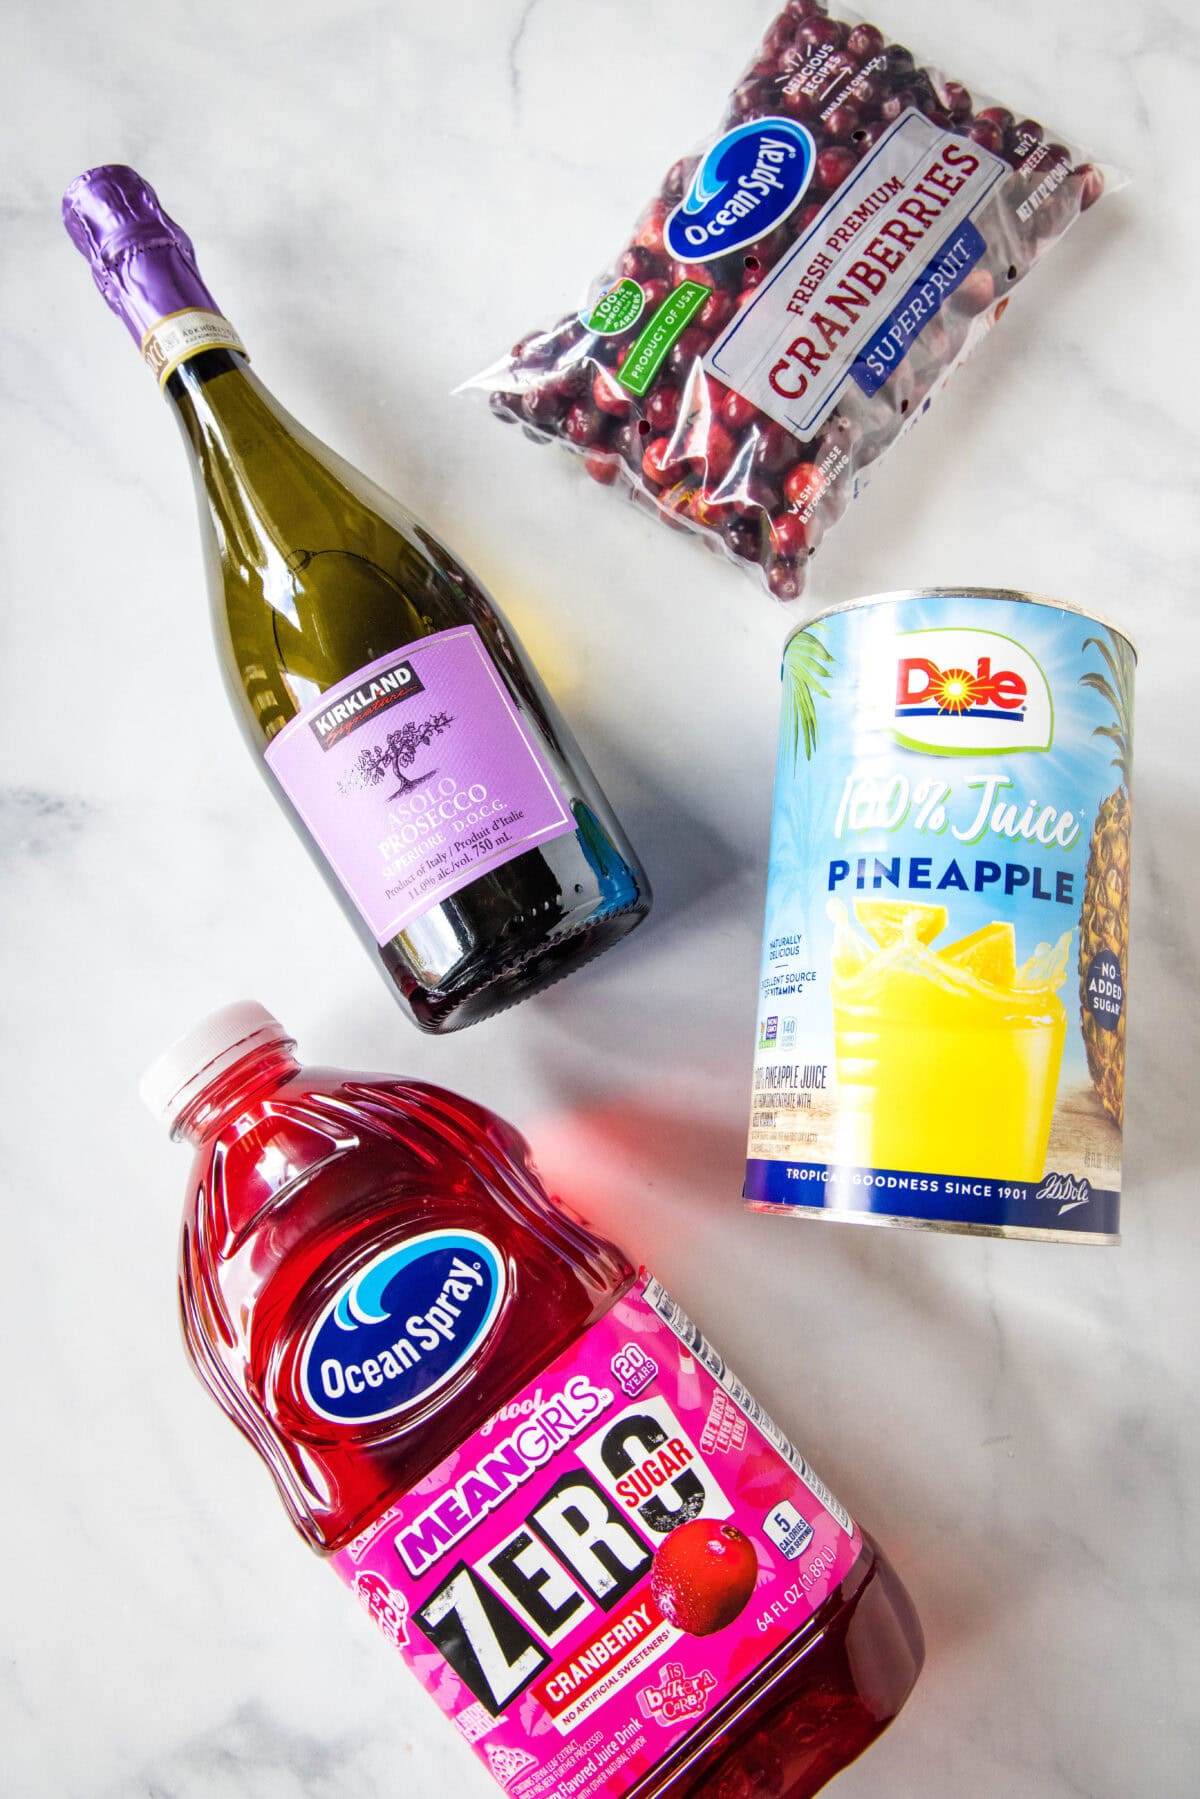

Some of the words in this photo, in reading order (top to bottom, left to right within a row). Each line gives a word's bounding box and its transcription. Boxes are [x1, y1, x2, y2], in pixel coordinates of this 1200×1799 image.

[782, 44, 834, 95] DELICIOUS
[801, 56, 841, 96] RECIPES
[820, 85, 855, 120] AVAILABLE
[1014, 139, 1032, 156] BUY
[1023, 133, 1037, 143] 2
[685, 189, 761, 245] Ocean
[738, 137, 796, 197] Spray
[787, 252, 833, 316] FRESH
[825, 176, 906, 252] PREMIUM
[768, 143, 979, 399] CRANBERRIES
[596, 287, 625, 319] 100%
[606, 290, 633, 325] PROFITS
[613, 293, 641, 329] FARMERS
[866, 237, 971, 376] SUPERFRUIT
[631, 325, 667, 379] PRODUCT
[664, 309, 678, 325] OF
[675, 290, 696, 309] USA
[787, 485, 814, 515] WASH
[817, 445, 842, 475] RINSE
[798, 486, 826, 524] BEFORE
[823, 454, 849, 486] USING
[315, 667, 412, 736] KIRKLAND
[895, 657, 1027, 711] Dole
[389, 777, 457, 824] ASOLO
[452, 799, 508, 833] D.O.C.G.
[834, 774, 950, 842] 100%
[952, 775, 1080, 847] Juice
[378, 783, 487, 860] PROSECCO
[384, 875, 416, 900] Product
[416, 865, 427, 878] of
[426, 851, 448, 871] Italy
[453, 827, 491, 852] Produit
[471, 838, 494, 857] 750
[828, 857, 1074, 905] PINEAPPLE
[769, 934, 802, 949] NATURALLY
[769, 946, 800, 960] DELICIOUS
[785, 971, 817, 984] SOURCE
[1089, 977, 1122, 1000] ADDED
[1102, 962, 1116, 980] NO
[771, 985, 796, 997] VITAMIN
[797, 984, 803, 993] C
[1093, 996, 1120, 1015] SUGAR
[765, 1065, 800, 1089] PINEAPPLE
[800, 1065, 828, 1089] JUICE
[786, 1168, 846, 1184] TROPICA
[852, 1174, 939, 1192] GOODNESS
[945, 1182, 992, 1197] SINCE
[998, 1187, 1027, 1200] 1901
[321, 1338, 421, 1399] Ocean
[405, 1257, 484, 1351] Spray
[615, 1347, 644, 1379] 20
[626, 1361, 655, 1390] YEARS
[616, 1437, 694, 1508] SUGAR
[773, 1512, 791, 1533] 5
[779, 1519, 807, 1552] CALORIES
[420, 1414, 706, 1707] ZERO
[784, 1544, 796, 1559] PER
[794, 1527, 813, 1548] SERVING
[756, 1611, 774, 1632] 64
[770, 1601, 789, 1618] FL
[783, 1584, 804, 1604] OZ
[799, 1557, 826, 1592] (1.89
[821, 1546, 837, 1570] L)
[545, 1602, 653, 1703] CRANBERRY
[669, 1665, 681, 1679] is
[703, 1672, 713, 1686] A
[562, 1711, 577, 1725] NO
[576, 1676, 619, 1715] ARTIFICIAL
[557, 1758, 598, 1797] Flavored
[594, 1741, 619, 1766] Juice
[614, 1716, 644, 1745] Drink
[574, 1730, 604, 1760] PROCESSED
[589, 1771, 608, 1792] OTHER
[604, 1753, 630, 1777] NATURAL
[625, 1735, 648, 1757] FLAVOR
